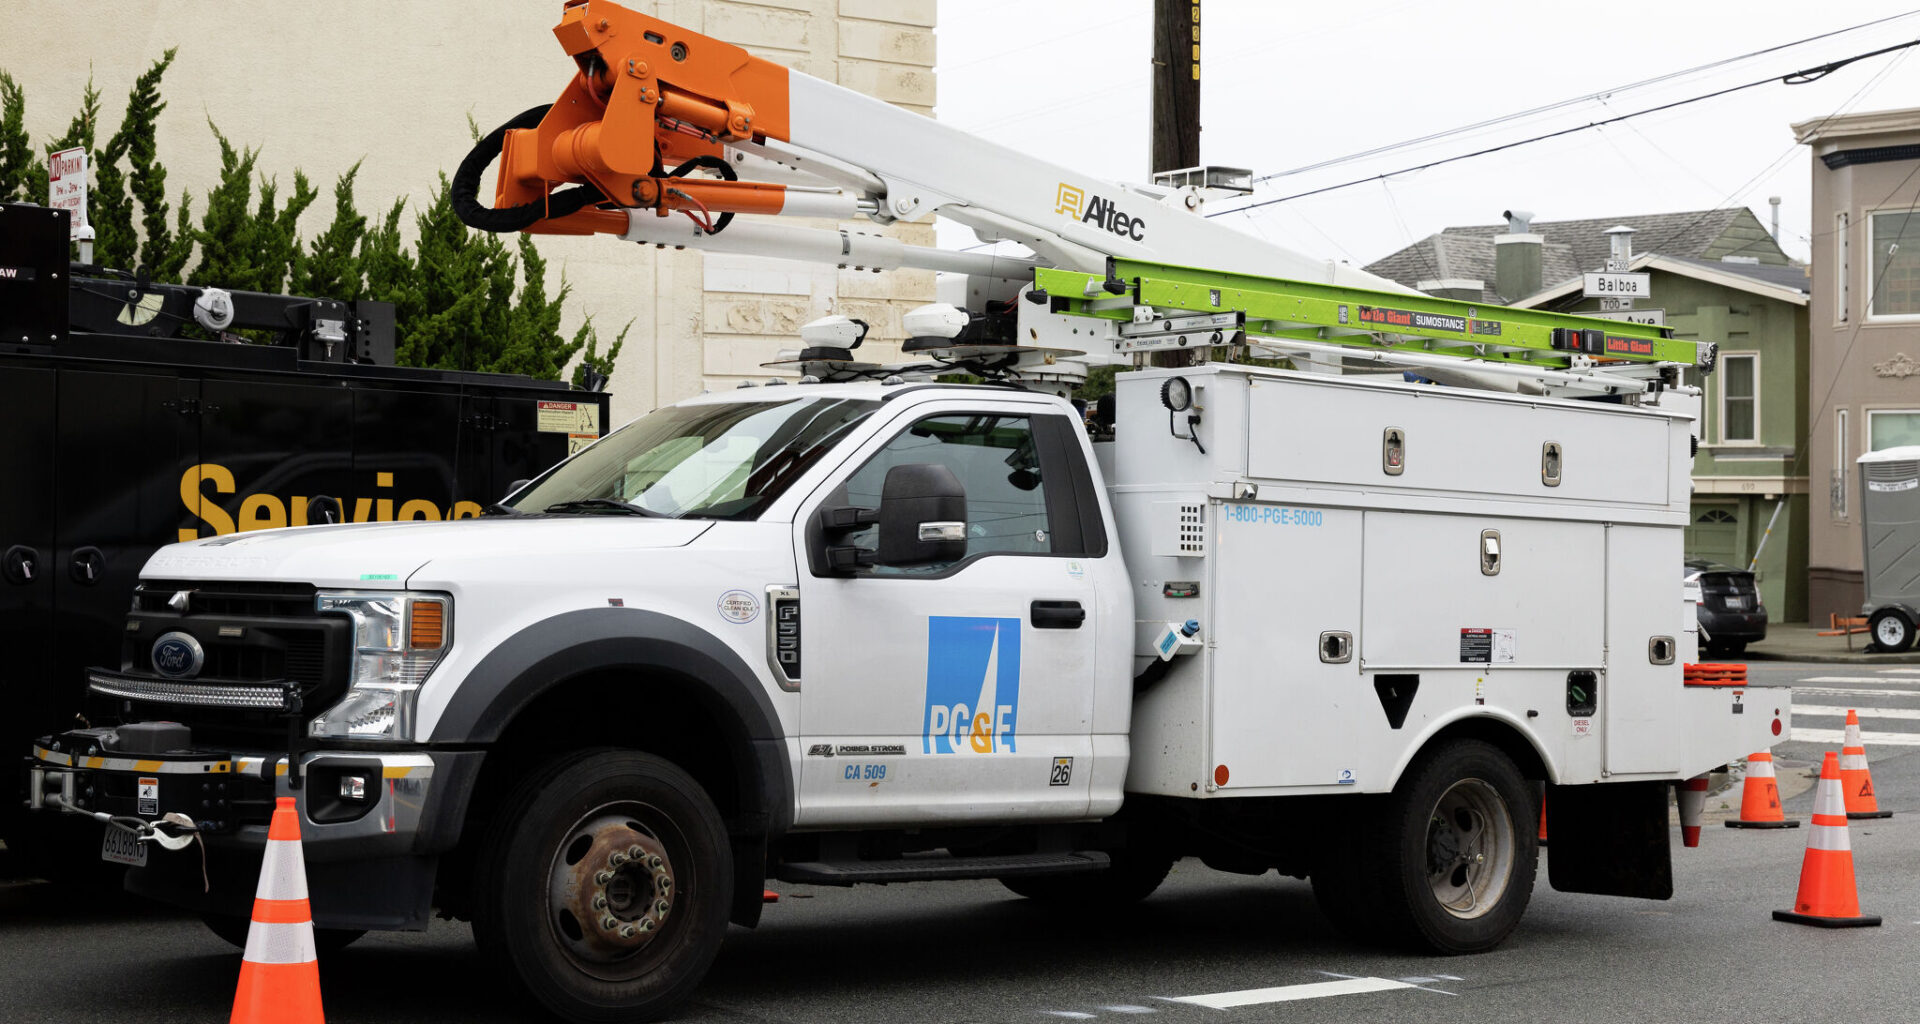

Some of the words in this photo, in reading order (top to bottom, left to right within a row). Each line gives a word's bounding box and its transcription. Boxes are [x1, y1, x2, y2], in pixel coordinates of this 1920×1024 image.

[49, 156, 60, 179] NO
[61, 157, 82, 175] PARKIN
[1082, 194, 1145, 242] Altec
[1598, 277, 1637, 292] Balboa
[1603, 300, 1620, 309] 700
[1387, 311, 1411, 326] Giant
[1415, 315, 1465, 330] SUMOSTANCE
[1607, 338, 1629, 351] Little
[1630, 340, 1651, 353] Giant
[1223, 504, 1323, 527] 1-800-PGE-5000
[779, 605, 798, 664] F550
[160, 645, 185, 668] Ford
[929, 702, 1014, 754] PG&E
[844, 764, 861, 780] CA
[864, 764, 887, 780] 509
[1052, 765, 1069, 783] 26
